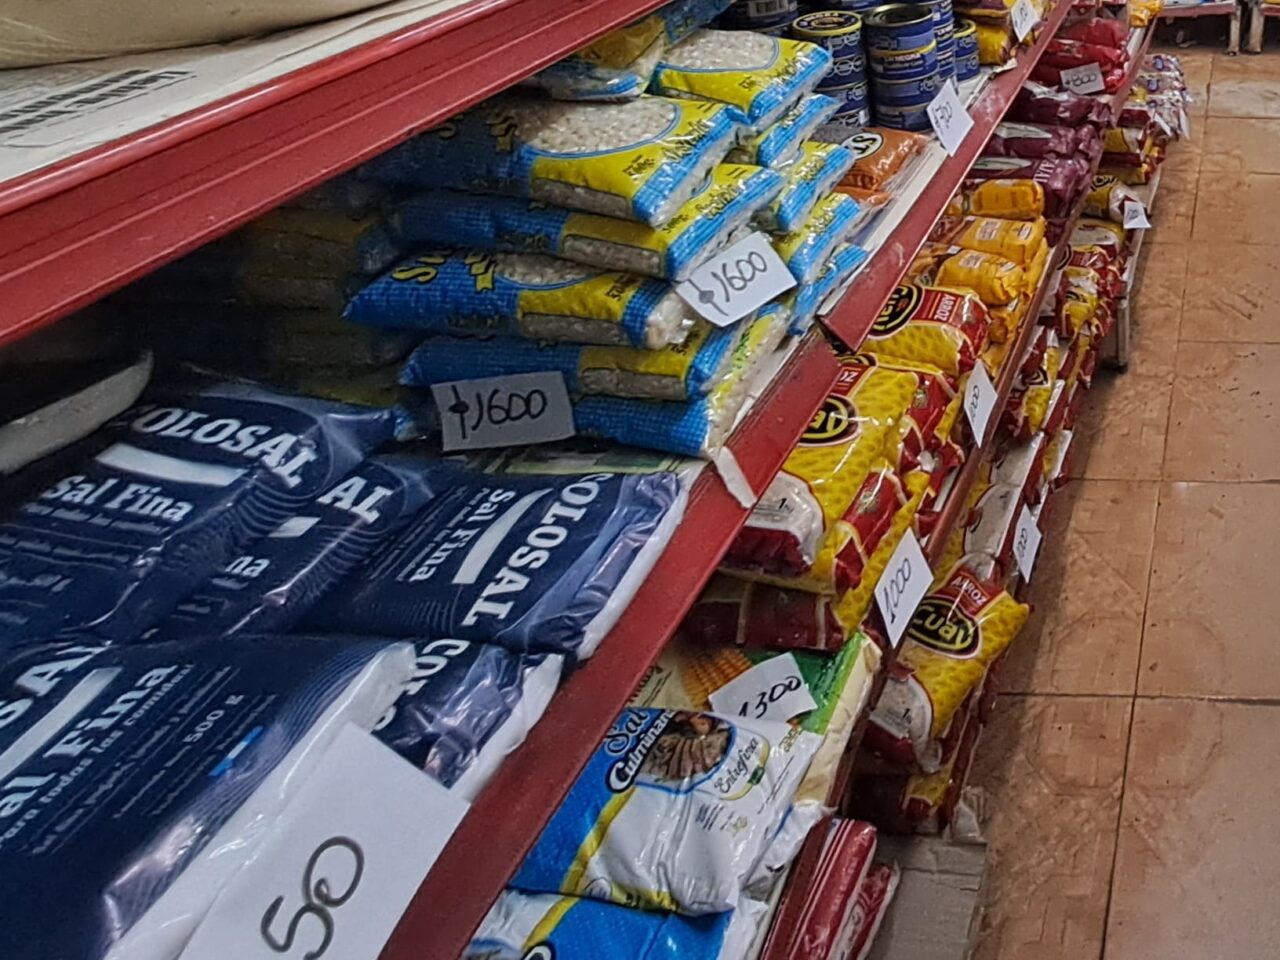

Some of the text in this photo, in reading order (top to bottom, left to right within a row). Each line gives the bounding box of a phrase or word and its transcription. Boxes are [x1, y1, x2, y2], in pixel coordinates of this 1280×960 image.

[41, 475, 101, 504] Sal
[103, 478, 195, 524] Fina
[469, 488, 516, 523] Sal
[951, 575, 989, 607] ARROZ
[43, 664, 179, 759] Fina
[738, 675, 803, 719] 1300
[184, 706, 228, 744] 500
[604, 708, 650, 755] Sal
[713, 736, 759, 795] Entrefina
